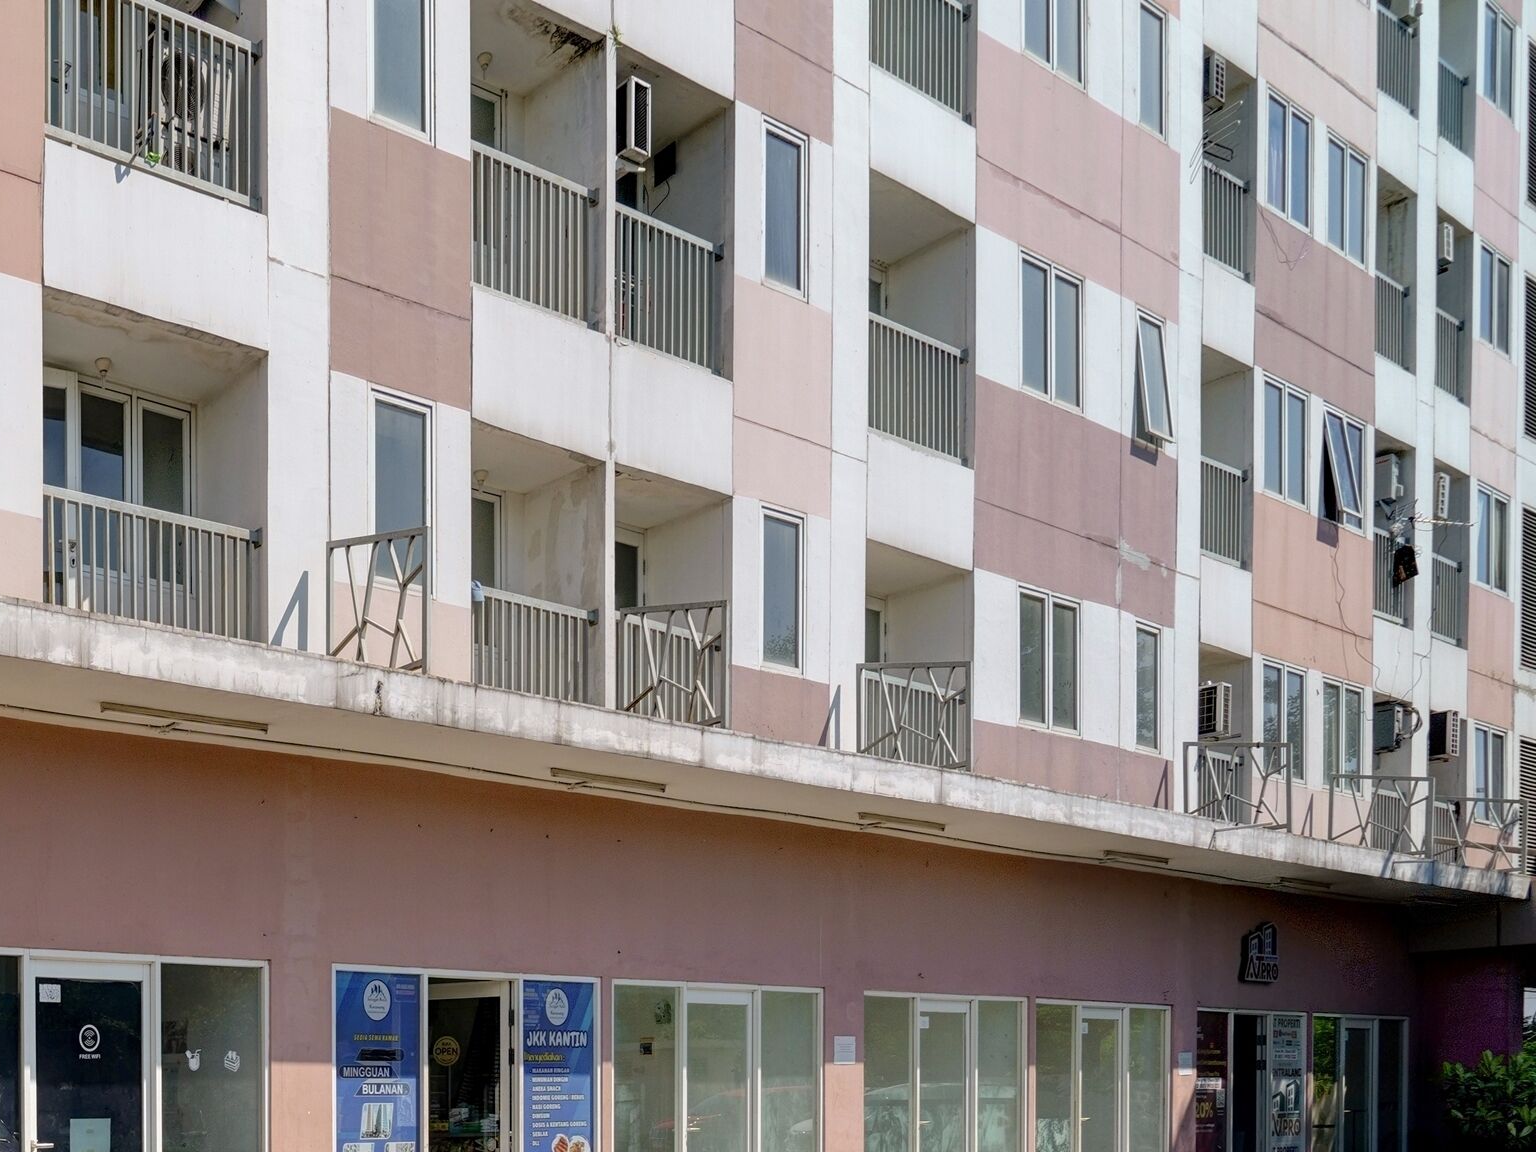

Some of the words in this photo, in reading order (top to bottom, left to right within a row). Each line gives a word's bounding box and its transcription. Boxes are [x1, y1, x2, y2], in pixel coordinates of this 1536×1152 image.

[526, 1030, 547, 1047] JKK
[549, 1030, 588, 1047] KANTIN
[434, 1047, 458, 1056] OPEN
[343, 1066, 390, 1077] MINGGUAN
[362, 1084, 404, 1095] BULANAN
